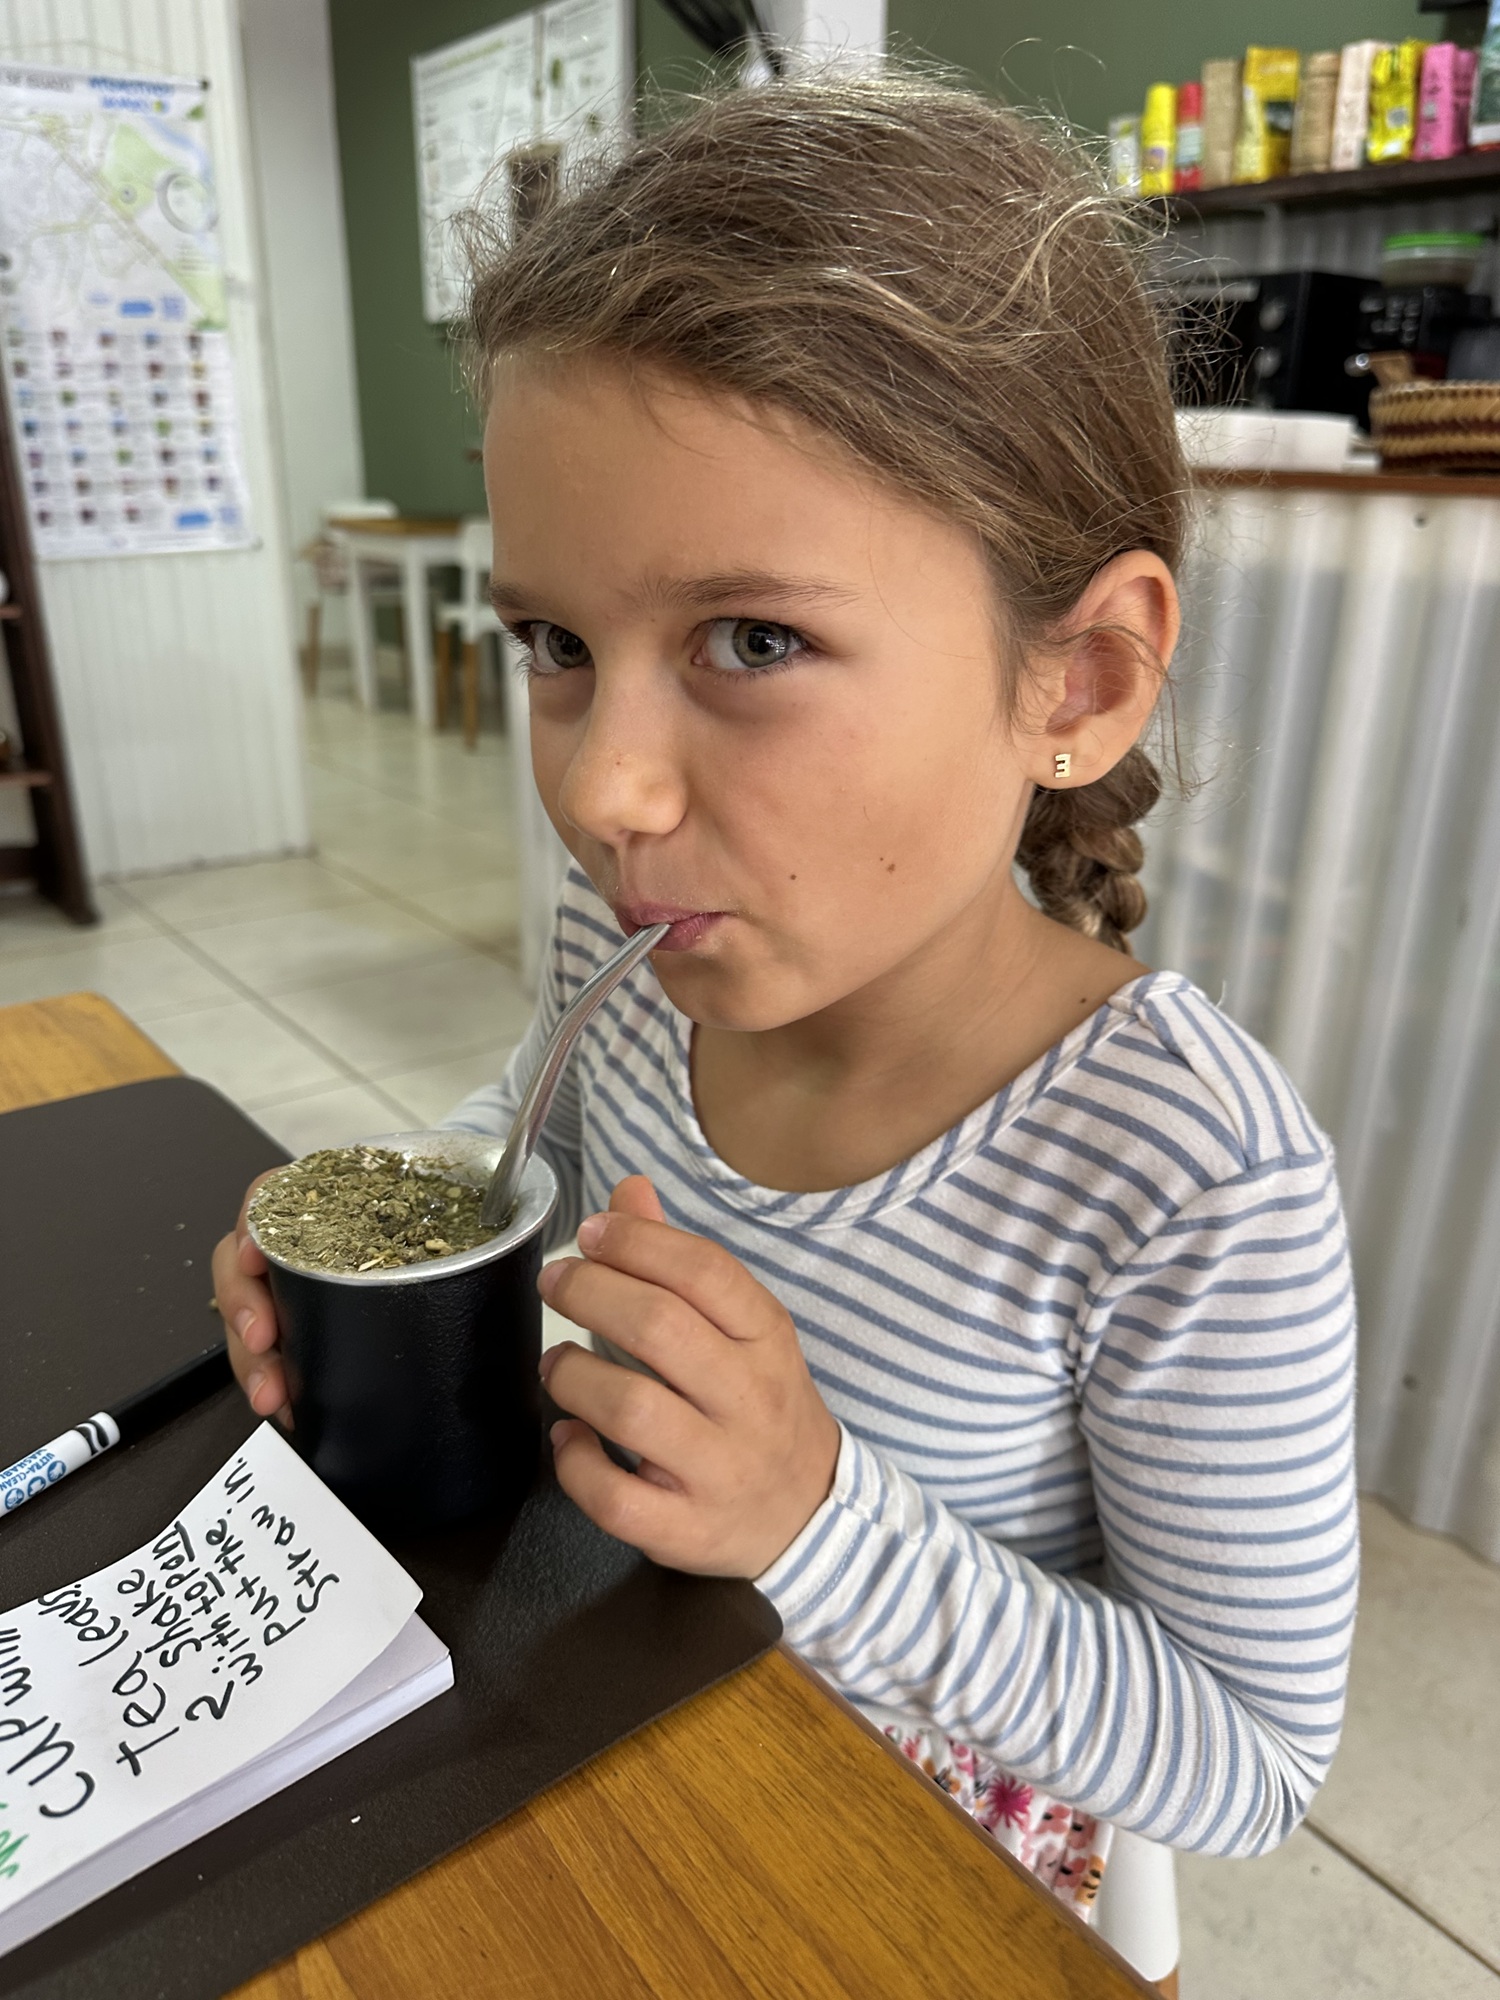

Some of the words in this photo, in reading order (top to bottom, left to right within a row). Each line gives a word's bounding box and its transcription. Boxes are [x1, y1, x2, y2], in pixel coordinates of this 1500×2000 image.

[0, 1452, 56, 1491] ULTRA-CLEAN
[205, 1518, 245, 1575] the
[200, 1612, 263, 1686] with
